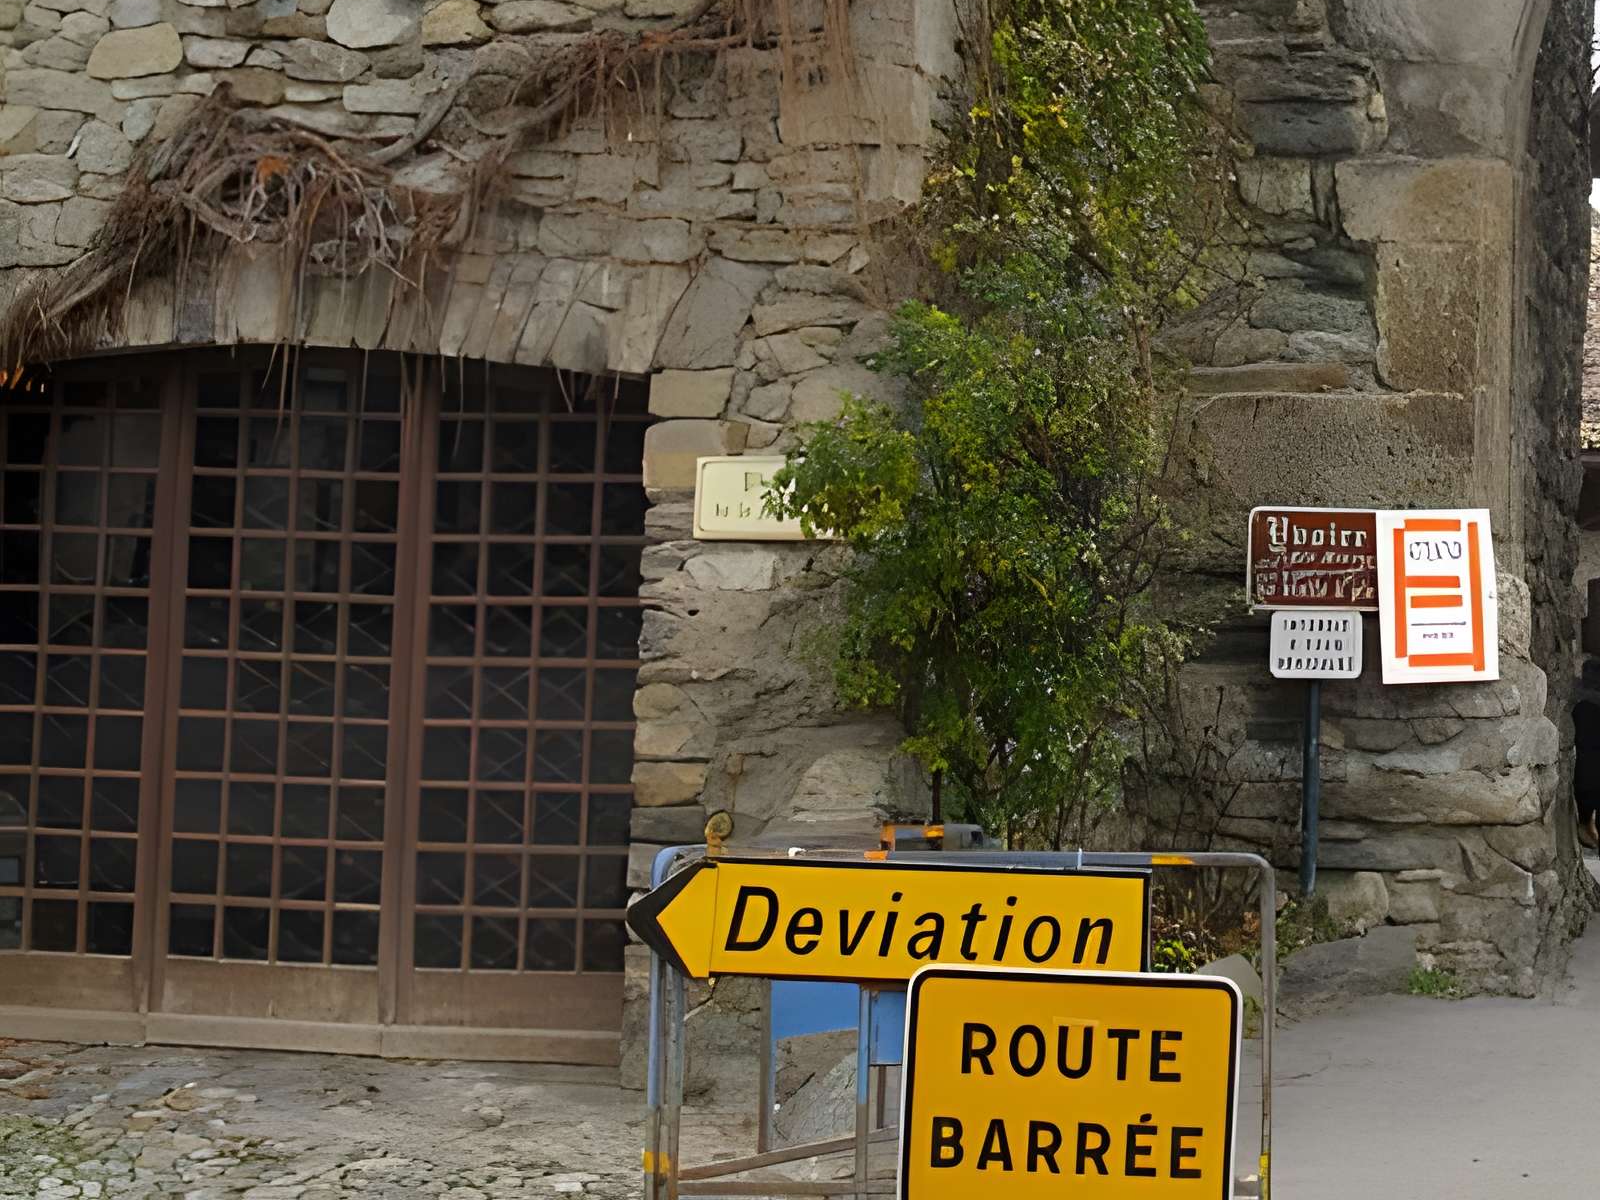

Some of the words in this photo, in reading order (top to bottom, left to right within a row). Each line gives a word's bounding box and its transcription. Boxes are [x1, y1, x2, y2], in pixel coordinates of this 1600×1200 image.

[724, 885, 1114, 965] Deviation
[961, 1023, 1182, 1083] ROUTE
[931, 1113, 1203, 1180] BARRÉE
